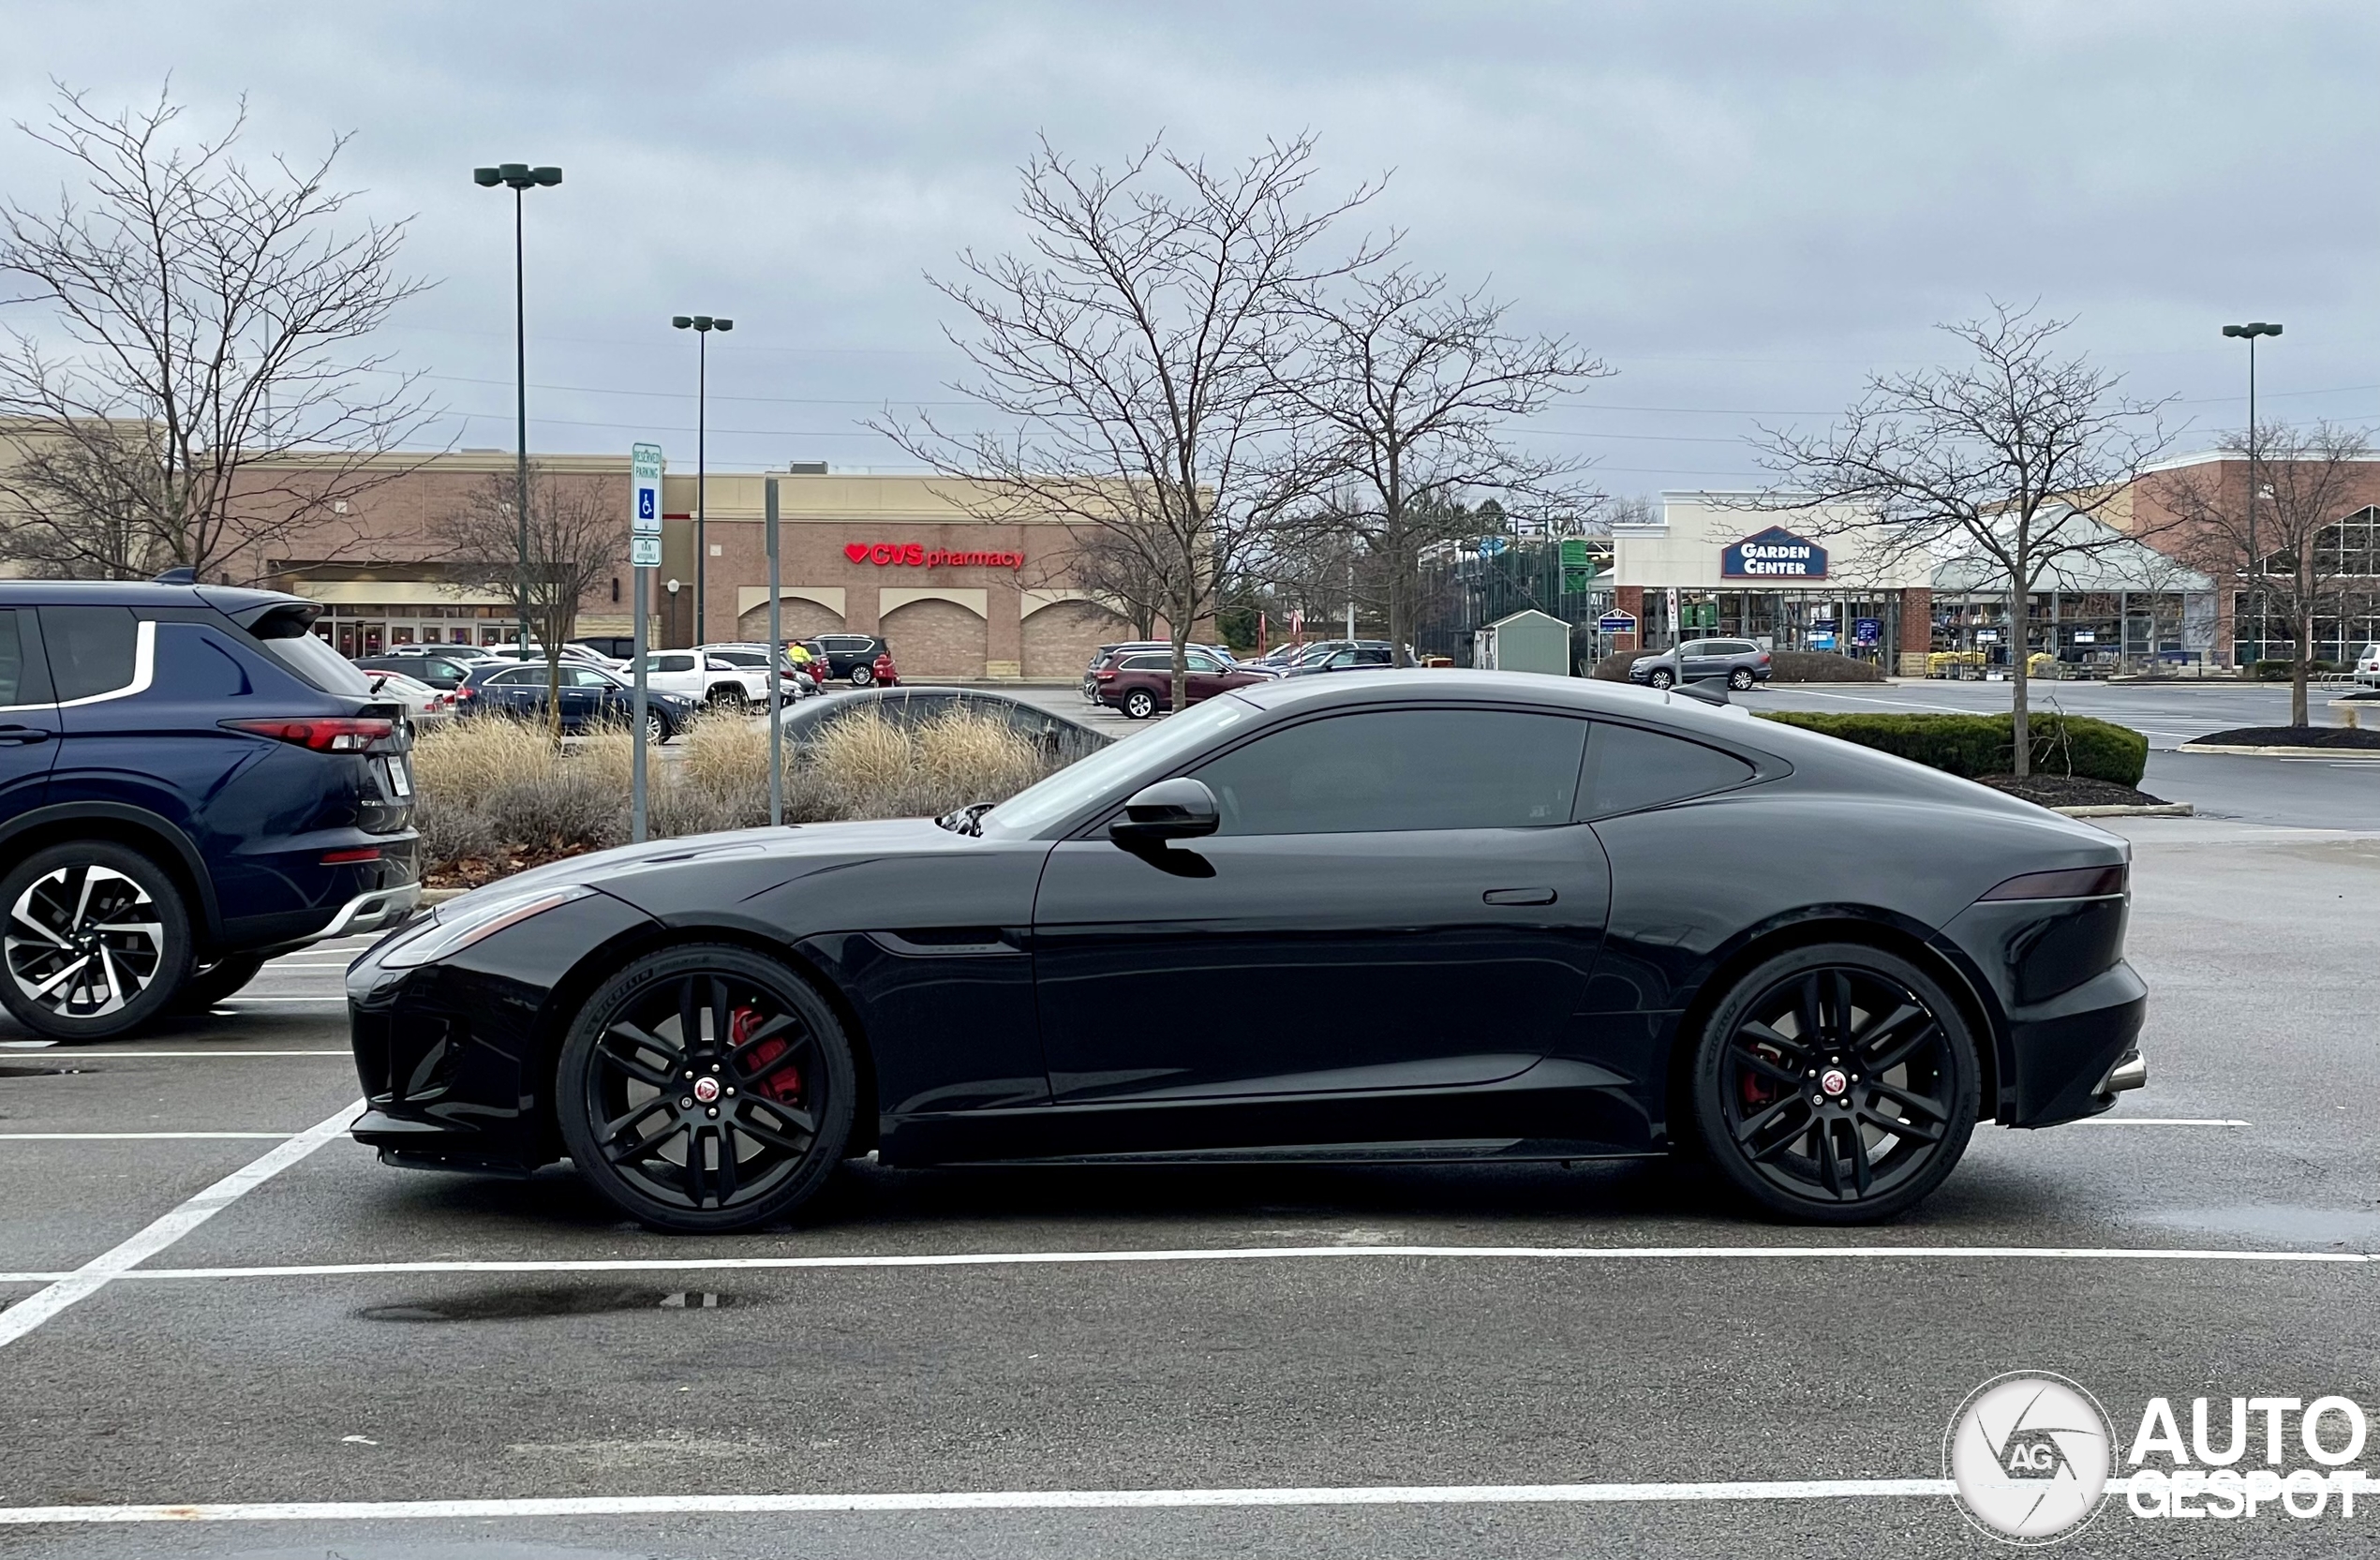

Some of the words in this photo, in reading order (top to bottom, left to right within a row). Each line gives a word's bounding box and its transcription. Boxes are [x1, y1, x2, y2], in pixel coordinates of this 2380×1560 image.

[636, 466, 658, 479] PARKING
[870, 542, 924, 566] CVS
[927, 547, 1024, 570] pharmacy
[1740, 542, 1810, 558] GARDEN
[1744, 557, 1807, 574] CENTER
